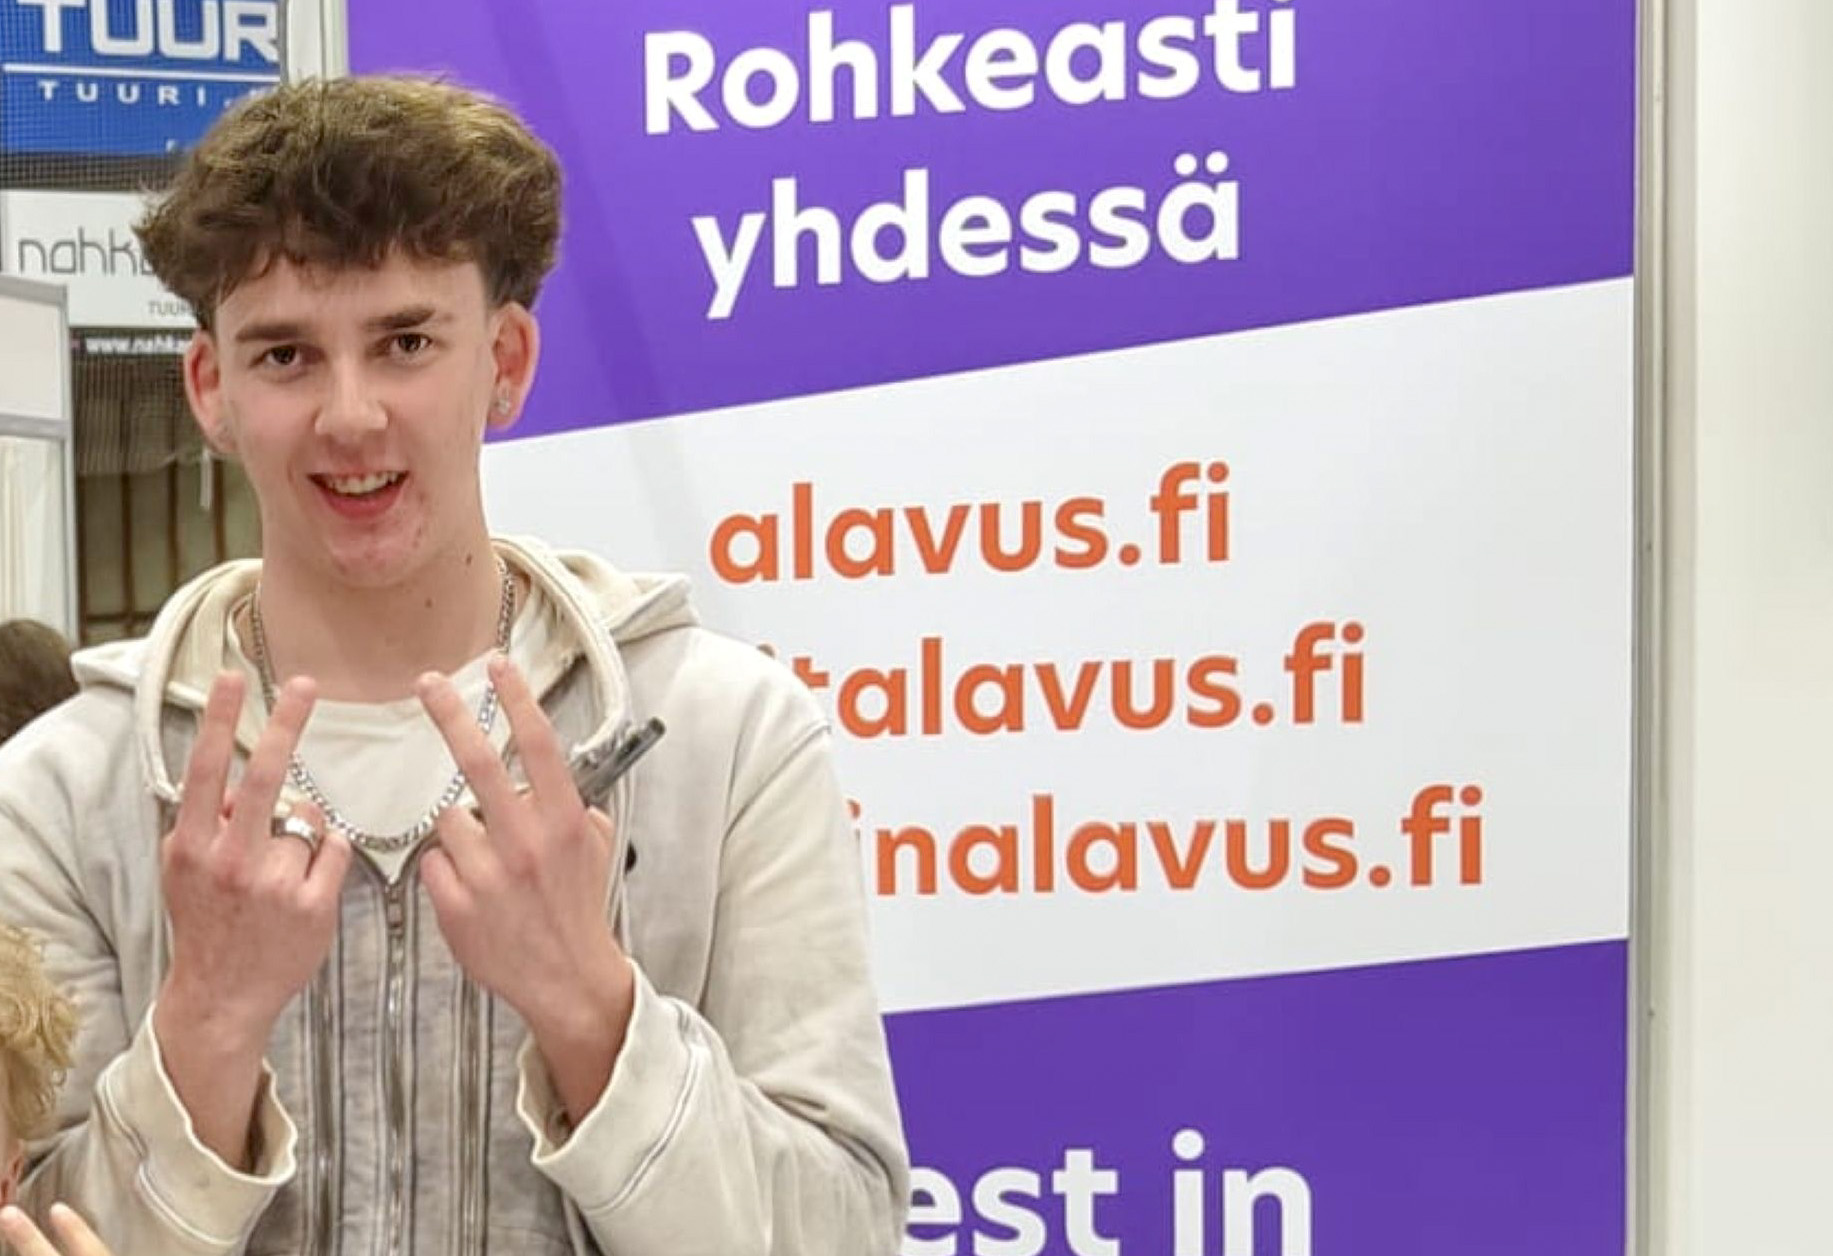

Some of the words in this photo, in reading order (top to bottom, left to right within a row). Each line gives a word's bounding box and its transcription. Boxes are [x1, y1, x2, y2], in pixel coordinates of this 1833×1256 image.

[644, 0, 1295, 134] Rohkeasti
[692, 152, 1239, 319] yhdessä
[709, 462, 1229, 584] alavus.fi
